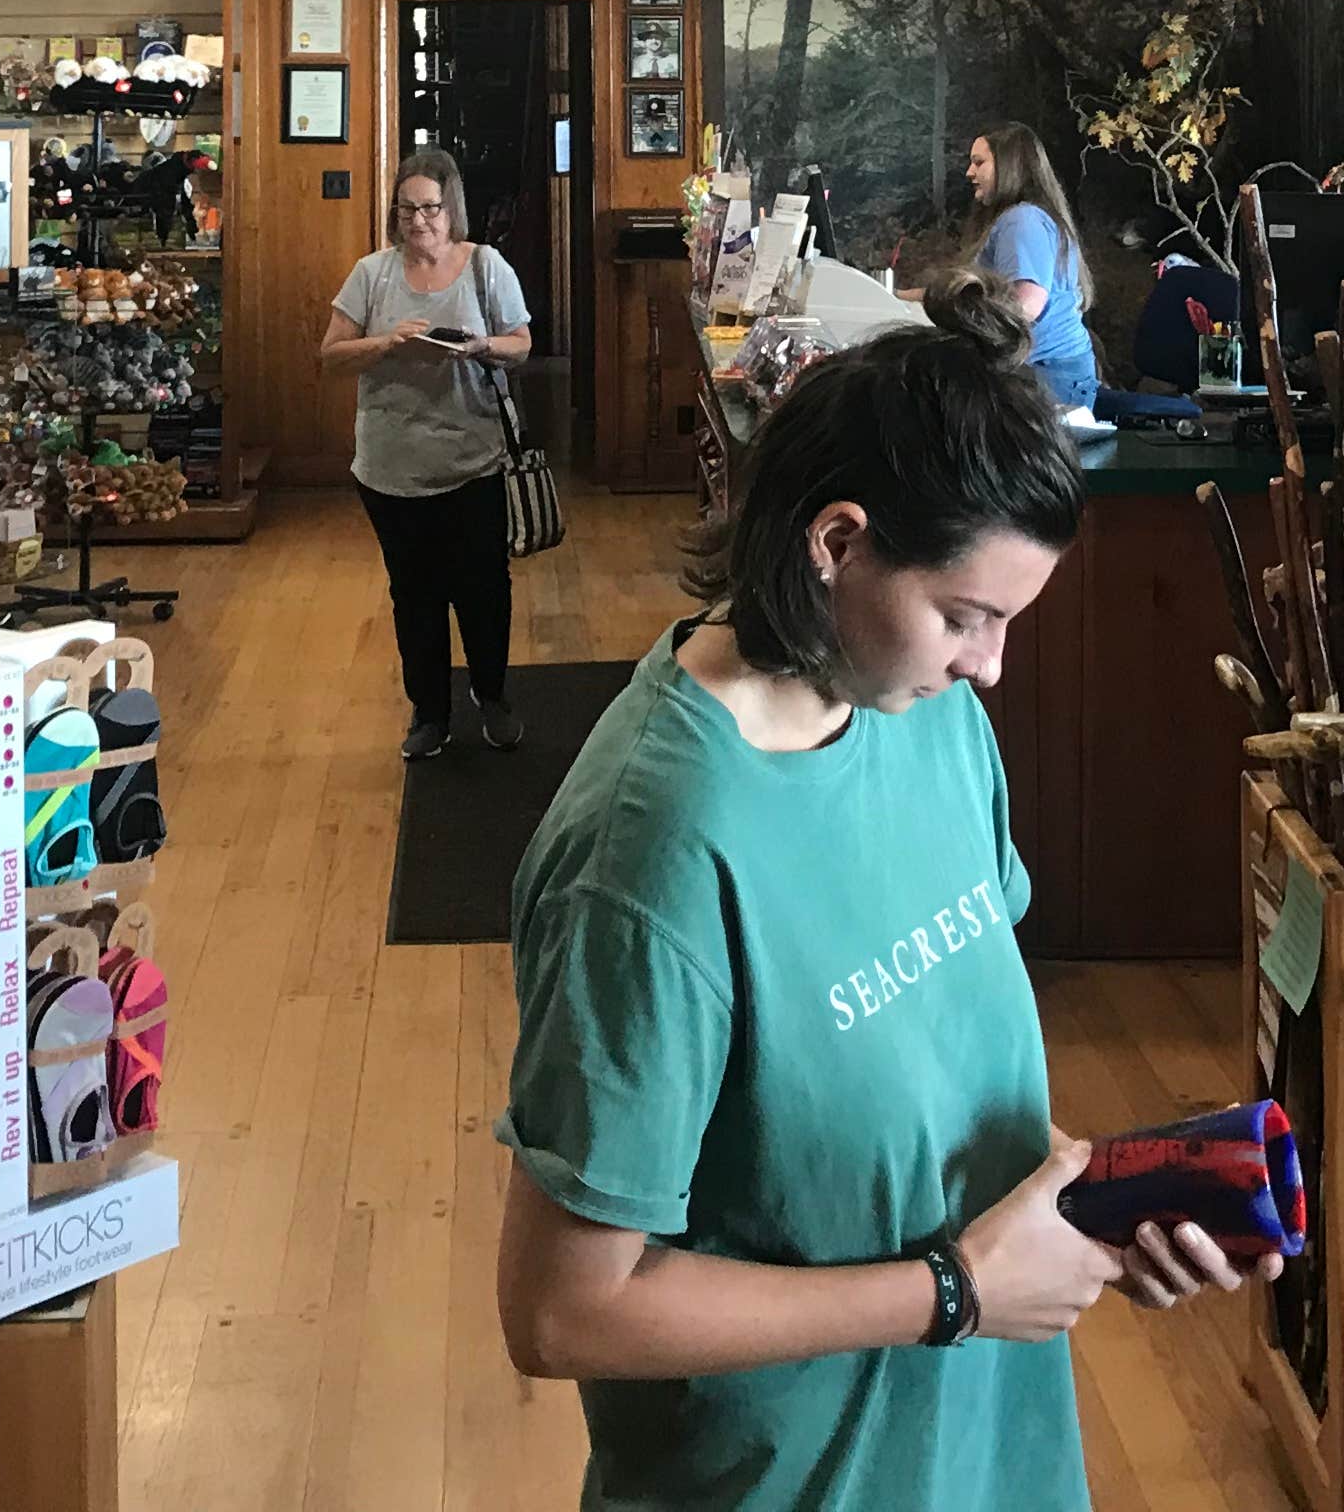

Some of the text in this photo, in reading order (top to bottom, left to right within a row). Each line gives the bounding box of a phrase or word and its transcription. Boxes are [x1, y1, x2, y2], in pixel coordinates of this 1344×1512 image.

[0, 848, 21, 933] Repeat
[829, 879, 1001, 1031] SEACREST
[2, 1088, 19, 1106] it
[1, 1115, 21, 1163] Rev
[19, 1264, 72, 1295] lifestyle
[74, 1241, 134, 1273] footwear
